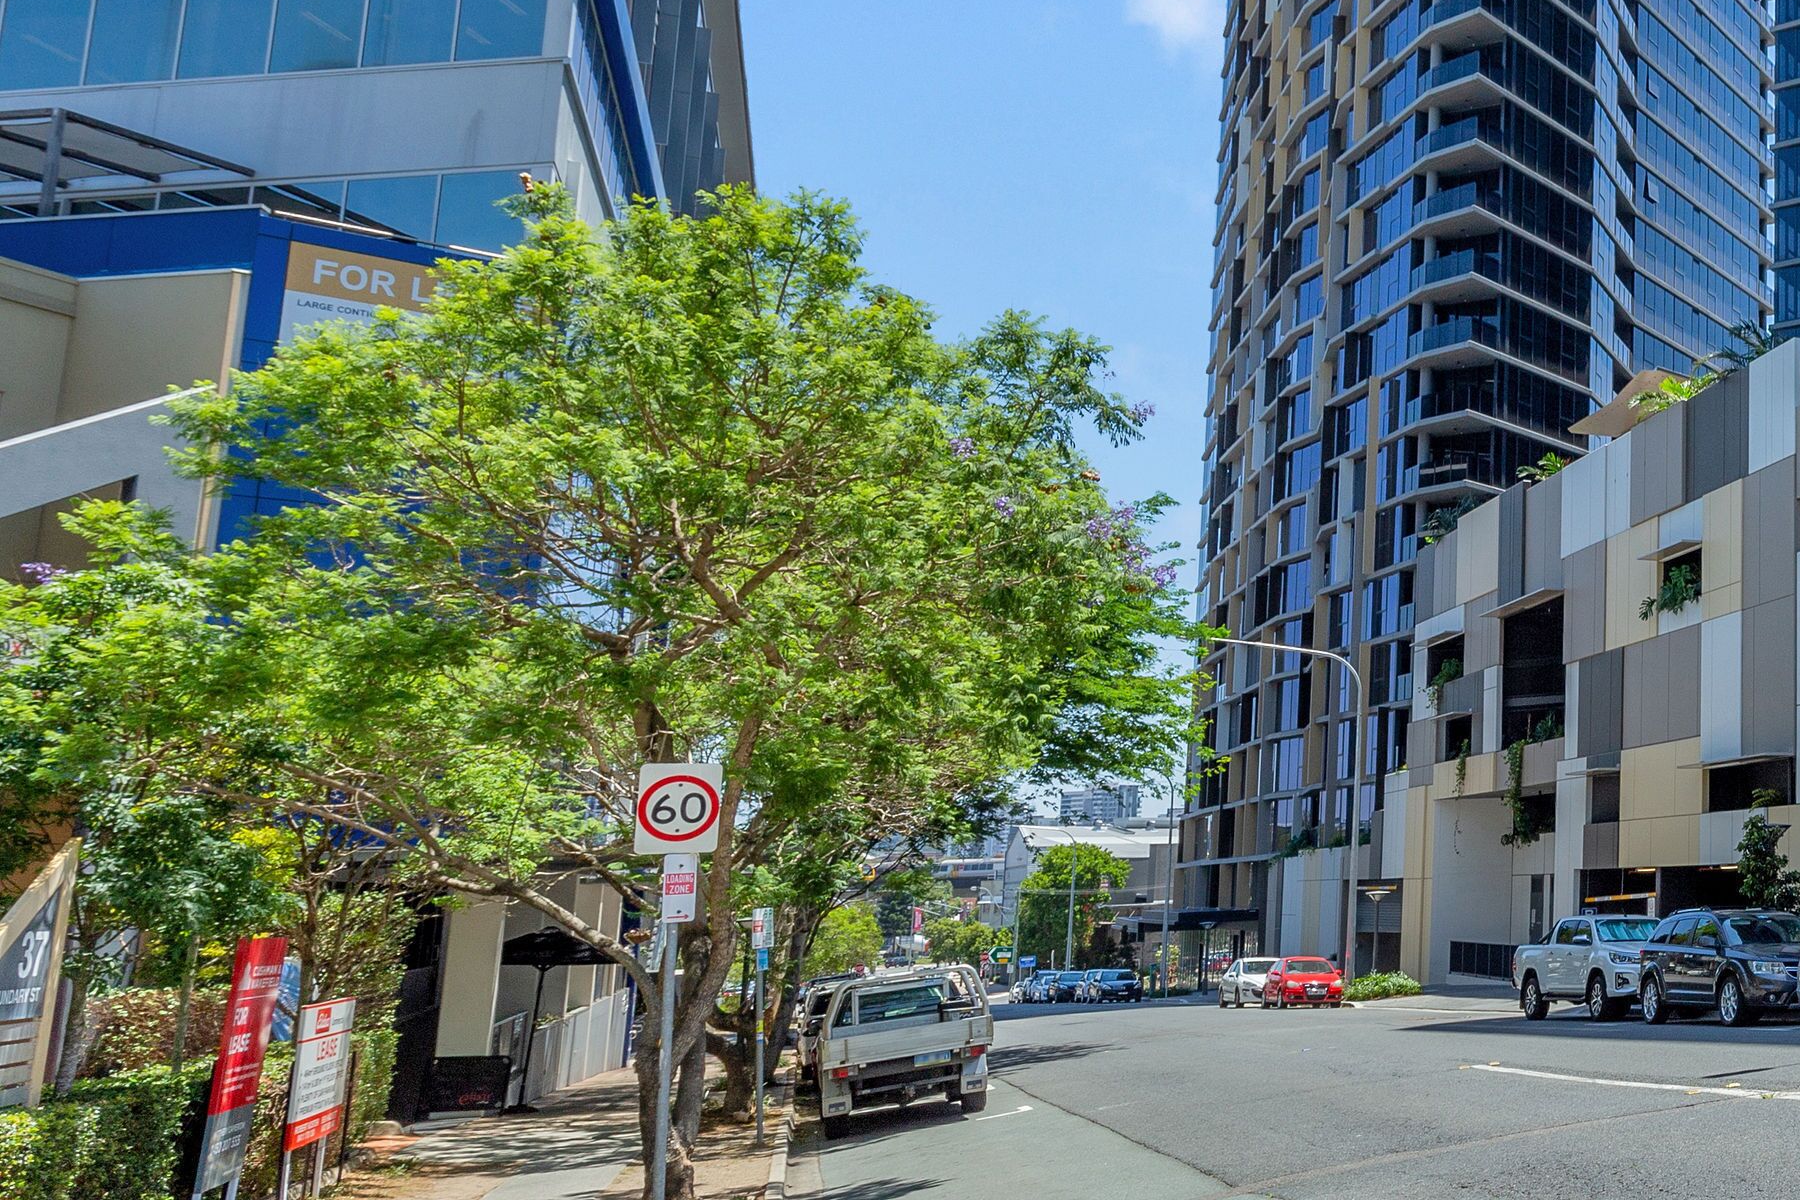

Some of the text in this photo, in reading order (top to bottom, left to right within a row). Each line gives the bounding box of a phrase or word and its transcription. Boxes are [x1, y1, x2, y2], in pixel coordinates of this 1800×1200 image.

[312, 258, 396, 298] FOR
[296, 299, 334, 312] LARGE
[651, 792, 707, 824] 60
[666, 873, 694, 884] LOADING
[669, 884, 690, 894] ZONE
[18, 930, 50, 979] 37
[29, 987, 41, 1003] ST
[233, 1006, 249, 1027] FOR
[228, 1033, 252, 1055] LEASE
[316, 1038, 338, 1061] LEASE
